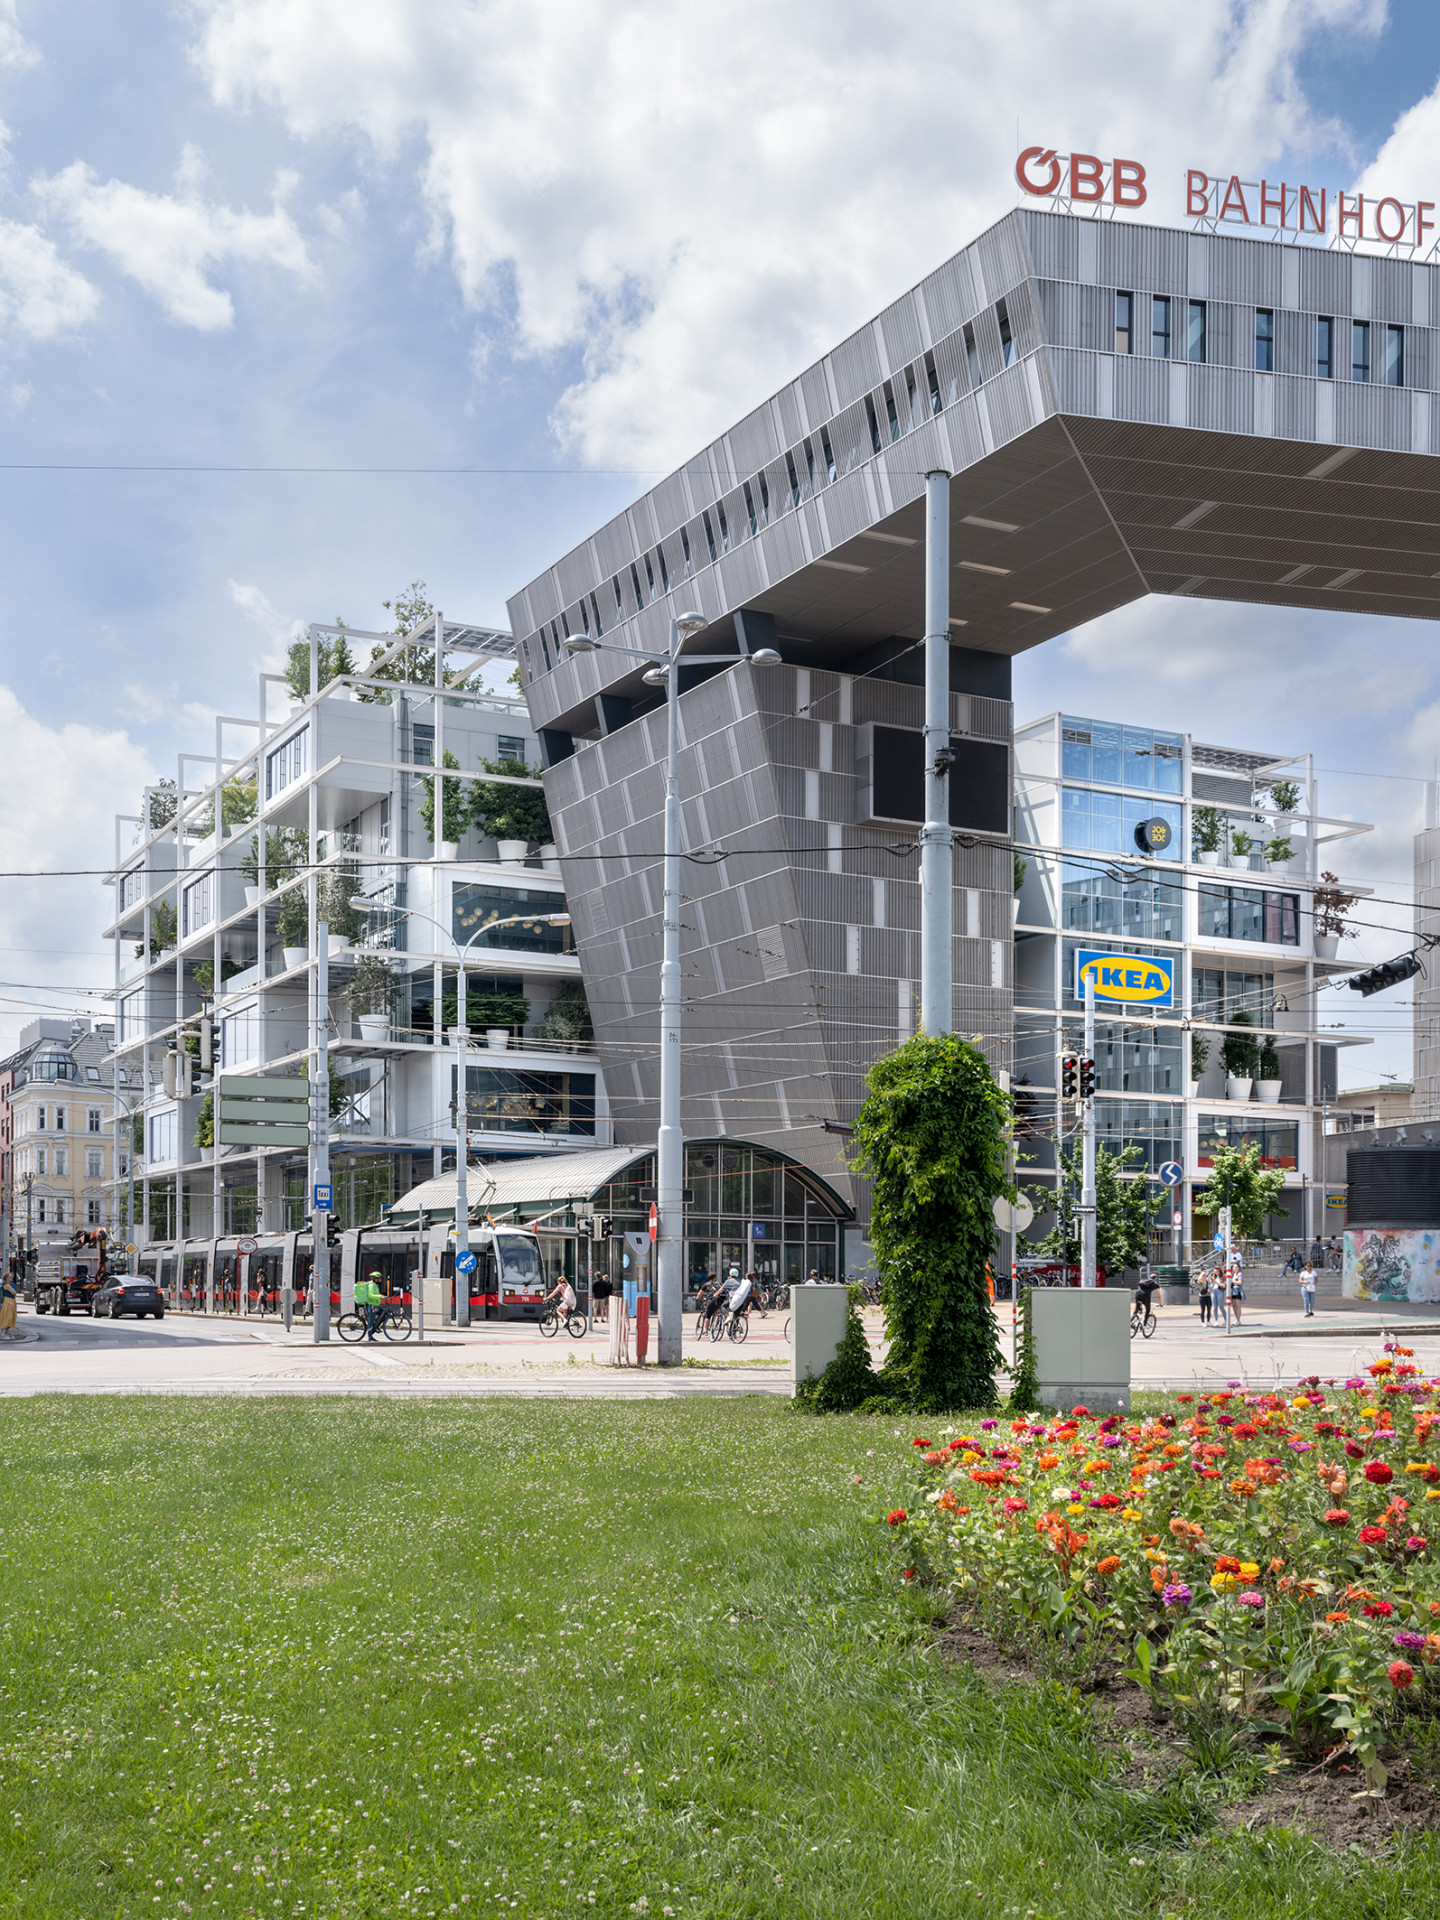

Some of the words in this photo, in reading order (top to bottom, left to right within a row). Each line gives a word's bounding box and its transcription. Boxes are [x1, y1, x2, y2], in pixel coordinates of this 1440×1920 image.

[1015, 146, 1147, 208] ÖBB
[1186, 168, 1435, 247] BAHNHOF
[1088, 965, 1165, 991] IKEA
[318, 1190, 329, 1198] Taxi
